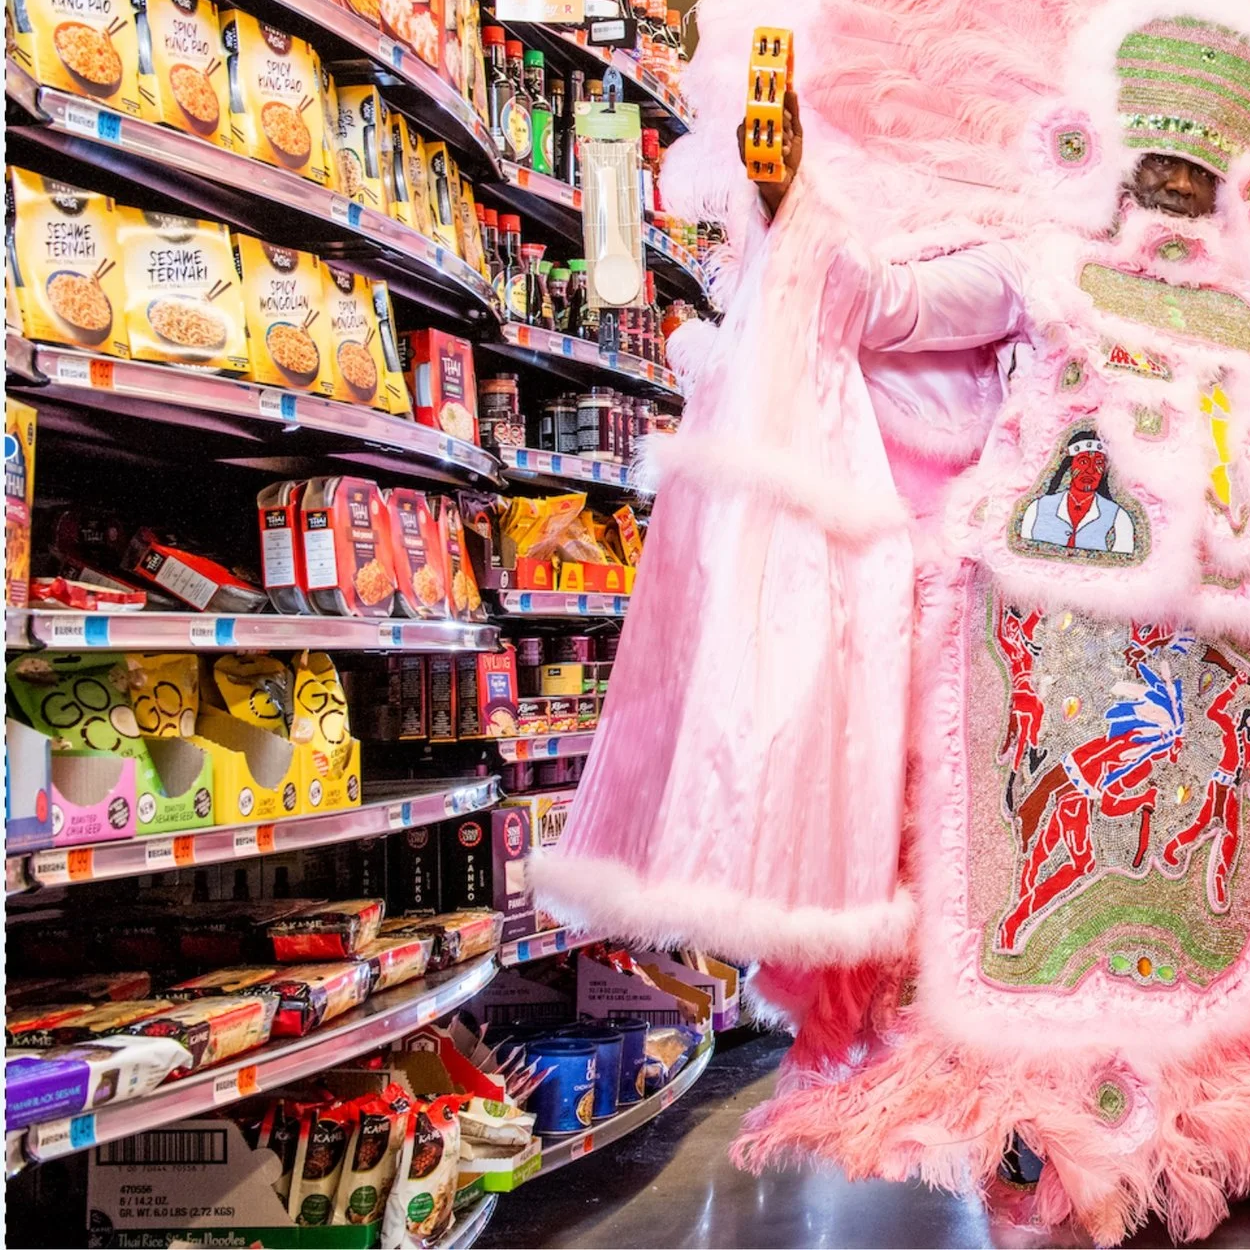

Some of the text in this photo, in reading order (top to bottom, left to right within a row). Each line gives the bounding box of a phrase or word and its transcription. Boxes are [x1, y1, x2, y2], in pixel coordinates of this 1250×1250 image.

[172, 19, 198, 38] SPICY
[164, 37, 209, 55] KUNG PAO
[266, 60, 291, 76] SPICY
[47, 222, 91, 241] SESAME
[45, 241, 96, 258] TERIYAKI
[149, 250, 202, 266] SESAME
[147, 266, 208, 282] TERIYAKI
[270, 280, 297, 295] SPICY
[259, 296, 309, 311] MONGOLIAN
[441, 356, 461, 377] THAI
[349, 503, 369, 521] THAI
[308, 516, 327, 526] THAI
[467, 855, 475, 901] PANKO
[170, 1207, 187, 1217] LBS
[118, 1234, 141, 1248] Thai
[142, 1233, 163, 1248] Rice
